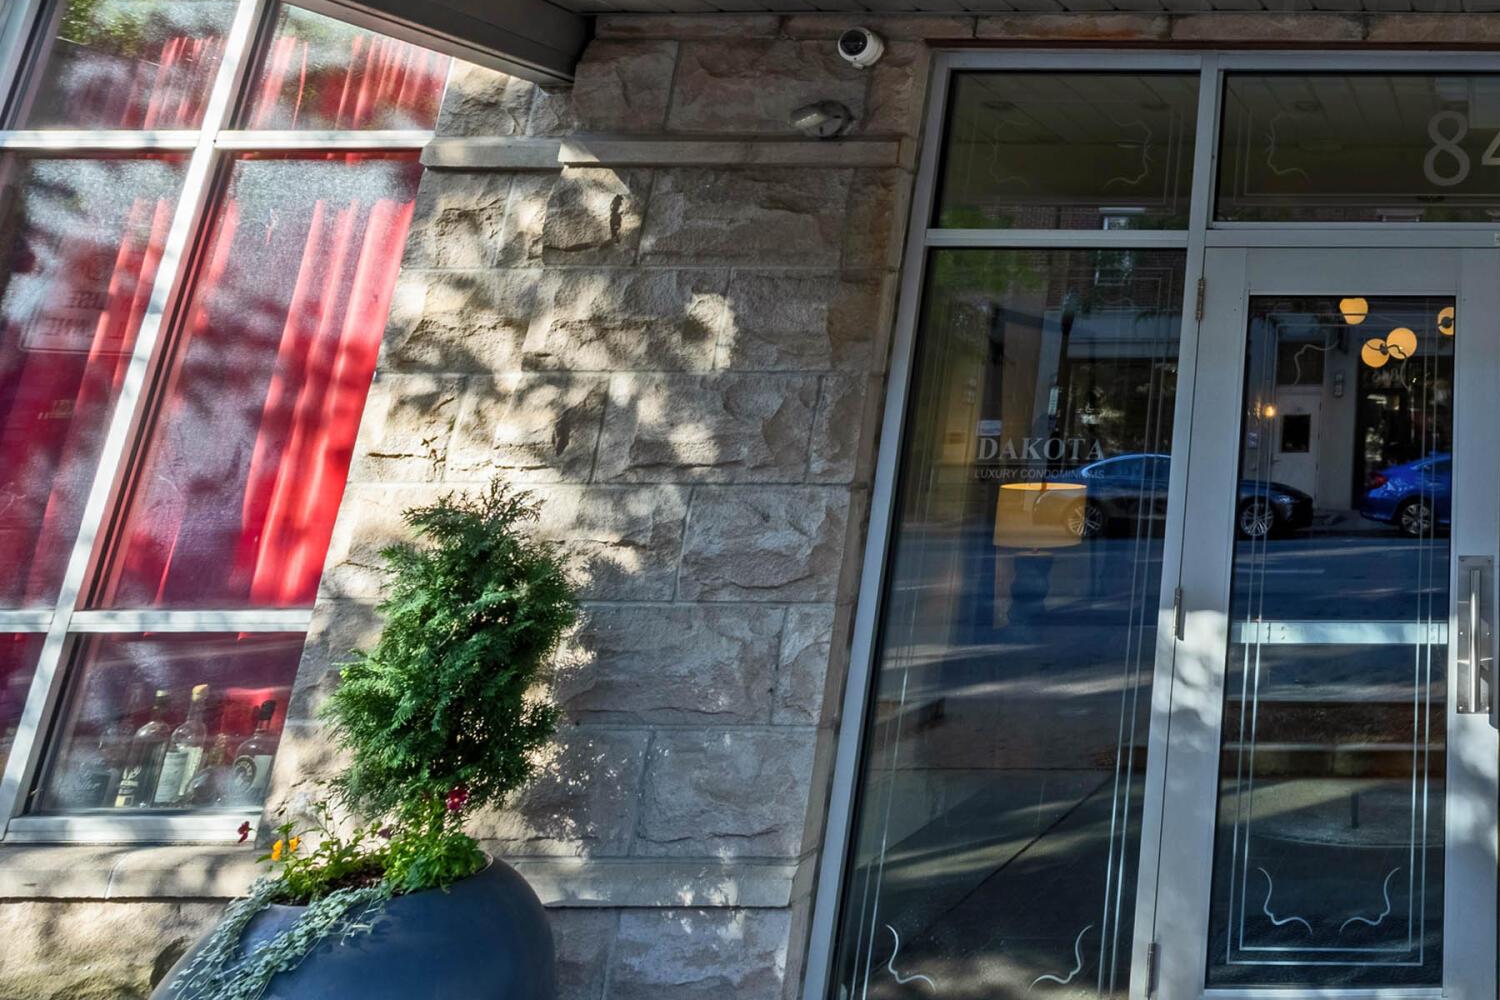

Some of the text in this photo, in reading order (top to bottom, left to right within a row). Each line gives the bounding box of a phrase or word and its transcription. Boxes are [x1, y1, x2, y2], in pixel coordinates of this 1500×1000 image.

[977, 437, 1106, 461] DAKOTA
[974, 469, 1105, 479] LUXURY CONDOMINIUMS
